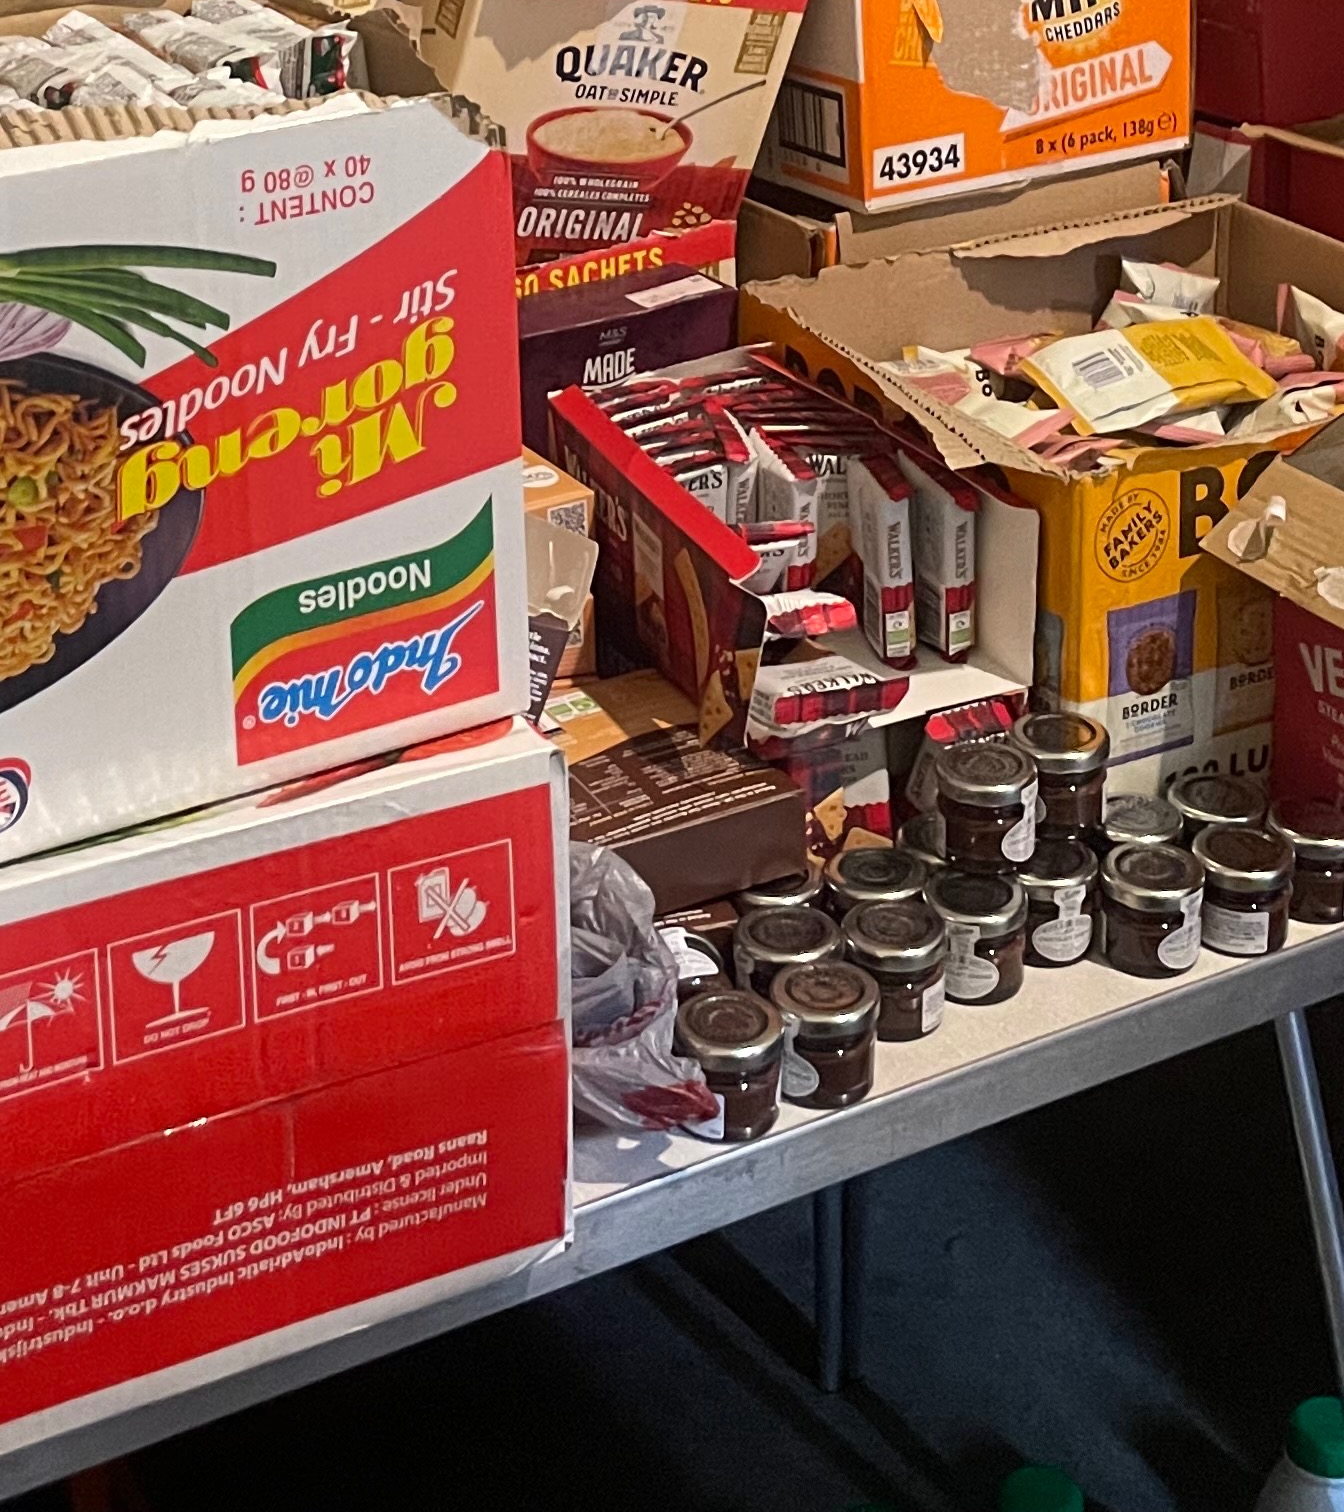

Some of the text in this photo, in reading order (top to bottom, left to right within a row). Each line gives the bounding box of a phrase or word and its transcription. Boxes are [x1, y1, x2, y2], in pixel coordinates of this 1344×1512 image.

[1045, 1, 1121, 43] CHEDDARS
[556, 44, 708, 92] QUAKER
[575, 84, 678, 106] OAT SIMPLE
[1048, 140, 1057, 153] x
[1061, 131, 1076, 155] (6
[1080, 124, 1118, 153] pack,
[1122, 119, 1155, 143] 138g
[242, 154, 371, 192] 40 x @80 g
[879, 142, 961, 181] 43934
[254, 181, 374, 225] CONTENT
[517, 206, 644, 241] ORIGINAL
[549, 247, 664, 289] SACHETS
[120, 269, 458, 451] Stir Fry Noodles
[583, 348, 636, 384] MADE
[116, 316, 455, 521] goreng
[310, 381, 457, 498] Mi
[1104, 500, 1152, 557] FAMILY
[1109, 511, 1162, 569] BAKERS
[298, 559, 431, 614] Noodles
[1229, 666, 1274, 690] BORDE
[1122, 693, 1178, 719] BORDER
[160, 1026, 180, 1040] NOT
[213, 1129, 487, 1225] Raans Road, Amersham, HP6 6FT
[399, 1174, 411, 1188] &
[415, 1152, 487, 1183] Imported
[439, 1172, 487, 1196] Under
[307, 1177, 395, 1216] Distributed
[382, 1188, 436, 1213] license
[228, 1213, 275, 1240] ASCO
[350, 1207, 371, 1223] PT
[378, 1193, 487, 1237] Manufactured
[172, 1231, 223, 1258] Foods
[250, 1214, 345, 1254] INDOFOOD
[355, 1228, 374, 1244] by
[138, 1250, 168, 1272] Ltd
[180, 1244, 246, 1279] SUKSES
[238, 1235, 344, 1278] IndoAdriatic
[52, 1279, 81, 1299] 7-8
[86, 1265, 124, 1286] Unit
[91, 1269, 175, 1306] MAKMUR
[161, 1271, 234, 1307] Industry
